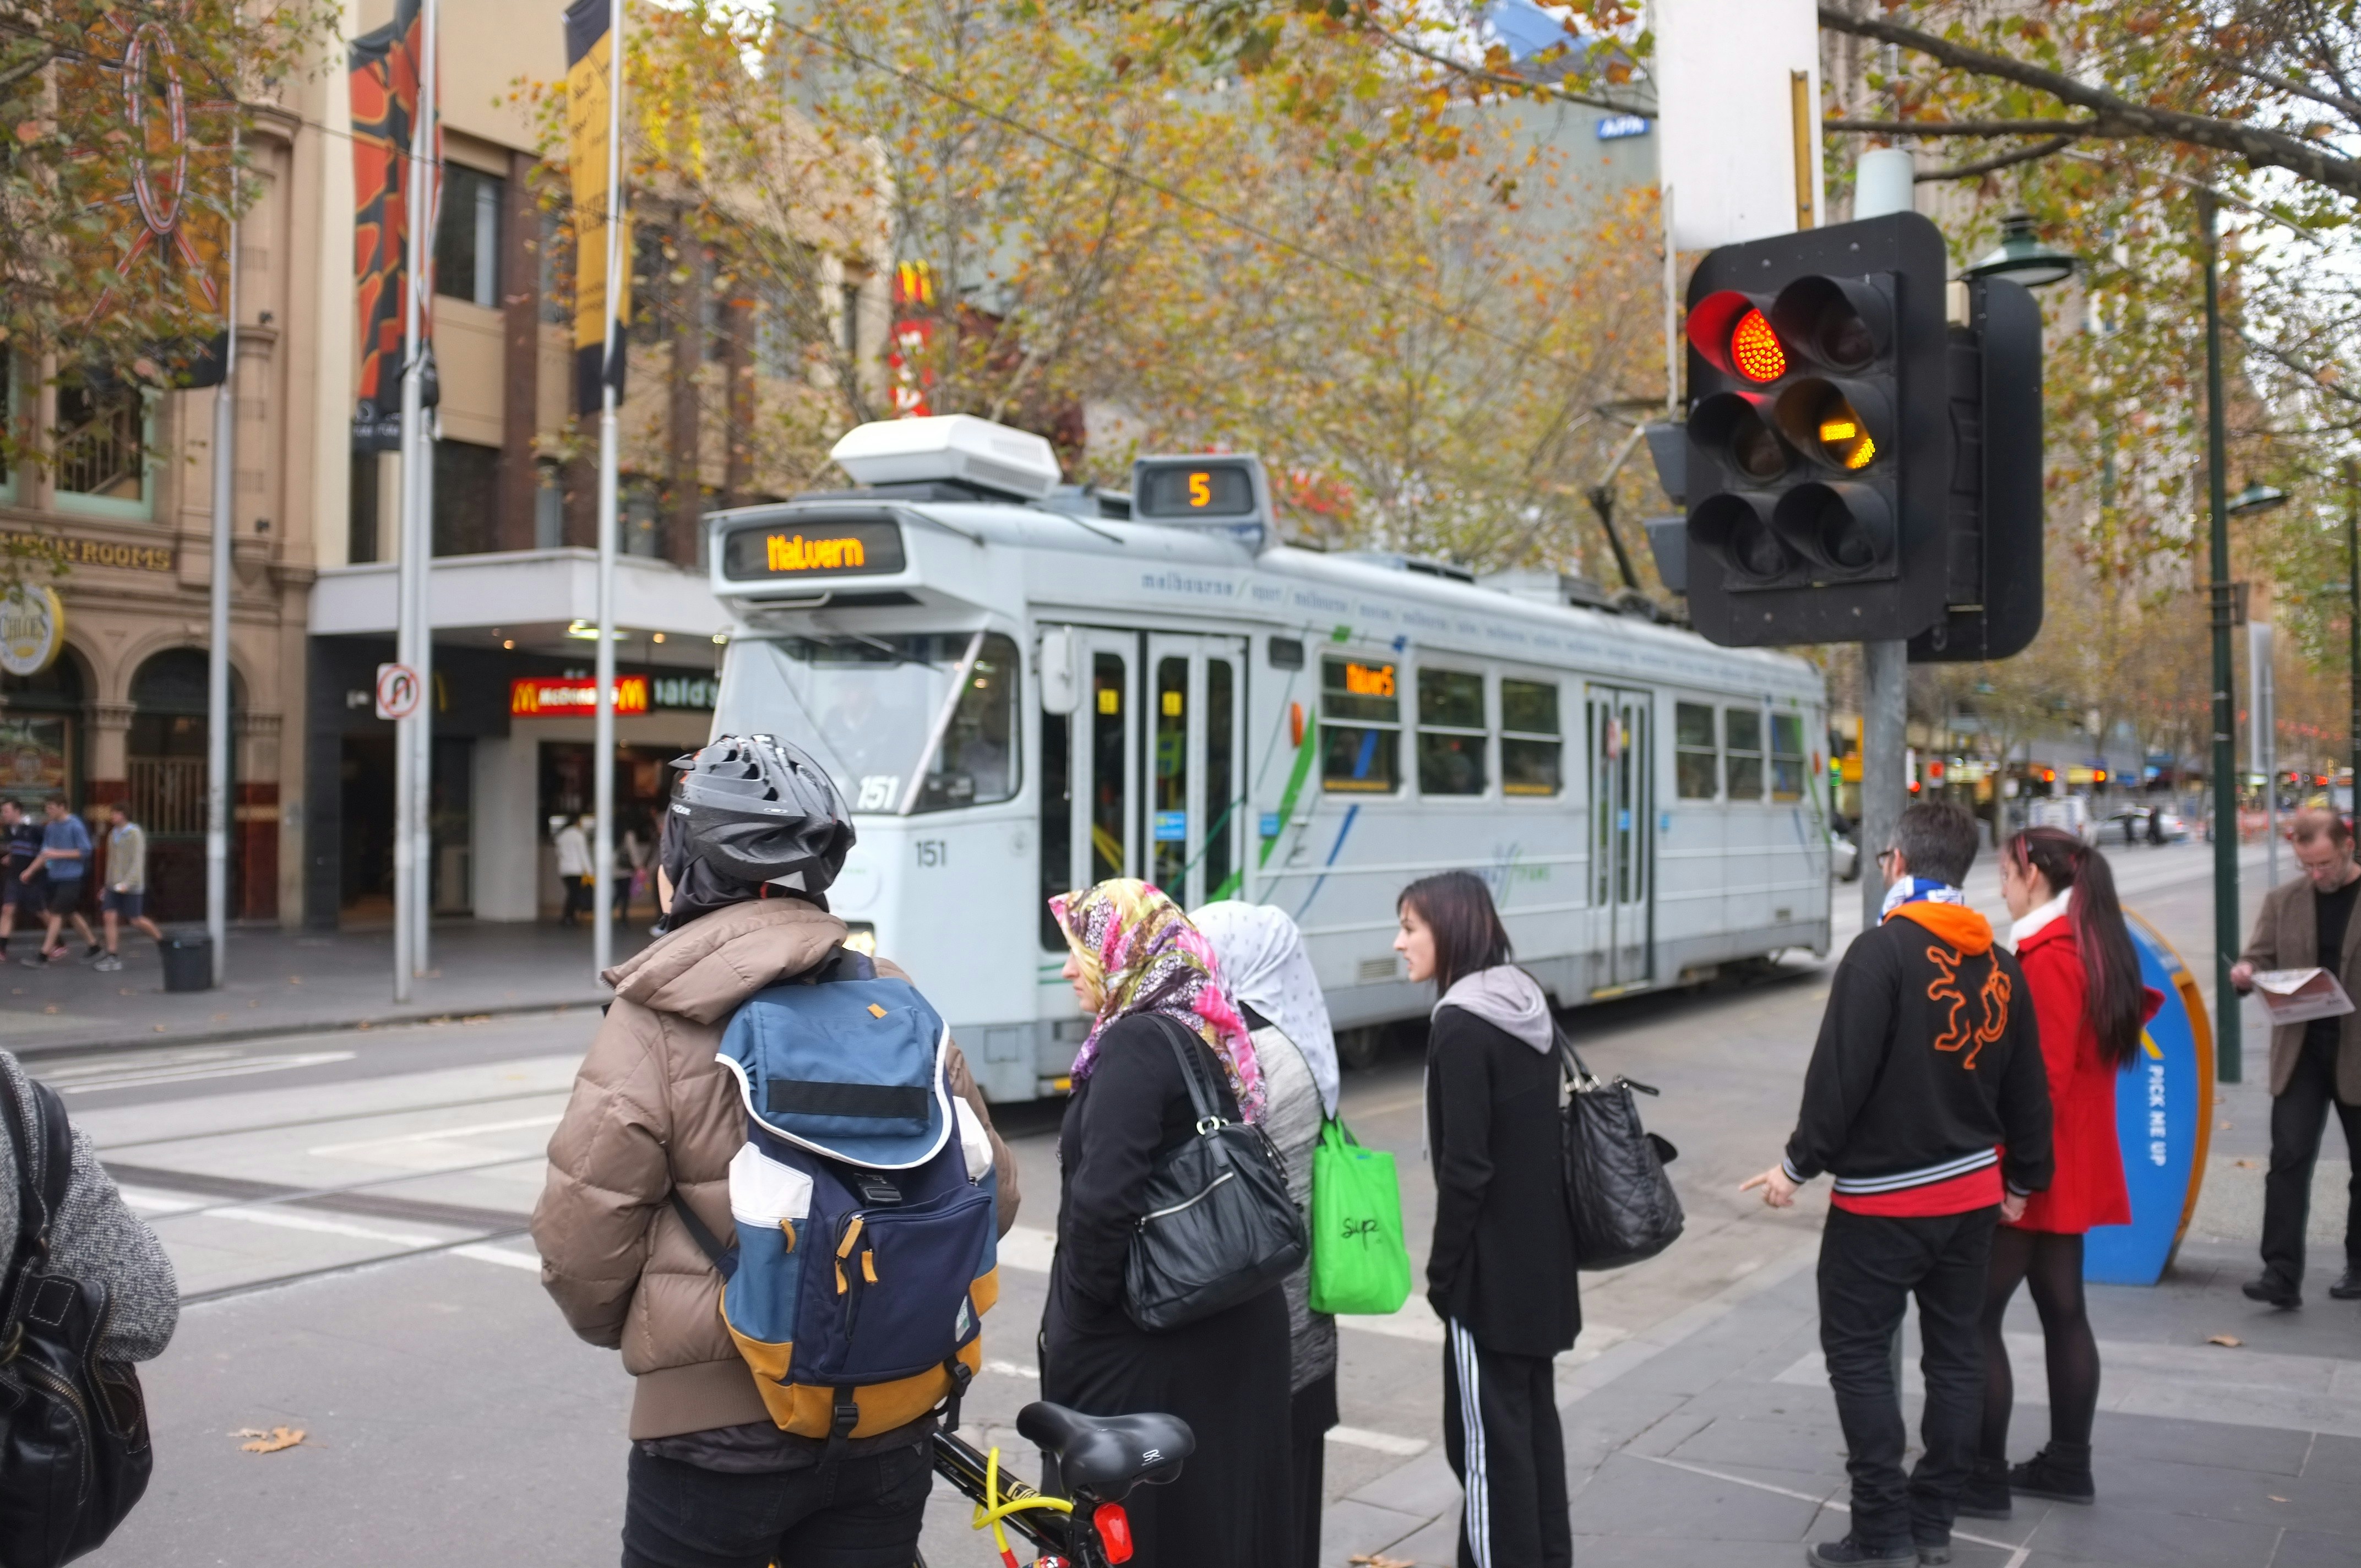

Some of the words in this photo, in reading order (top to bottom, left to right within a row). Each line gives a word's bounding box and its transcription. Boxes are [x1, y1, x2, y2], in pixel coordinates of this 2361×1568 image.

[1189, 472, 1210, 507] 5
[82, 540, 171, 571] ROOMS
[767, 533, 864, 571] Malvern
[1142, 570, 1232, 596] melbourne
[857, 775, 900, 810] 151
[916, 840, 947, 868] 151
[2148, 1065, 2166, 1108] PICK
[2149, 1110, 2166, 1138] ME
[2150, 1140, 2167, 1167] UP
